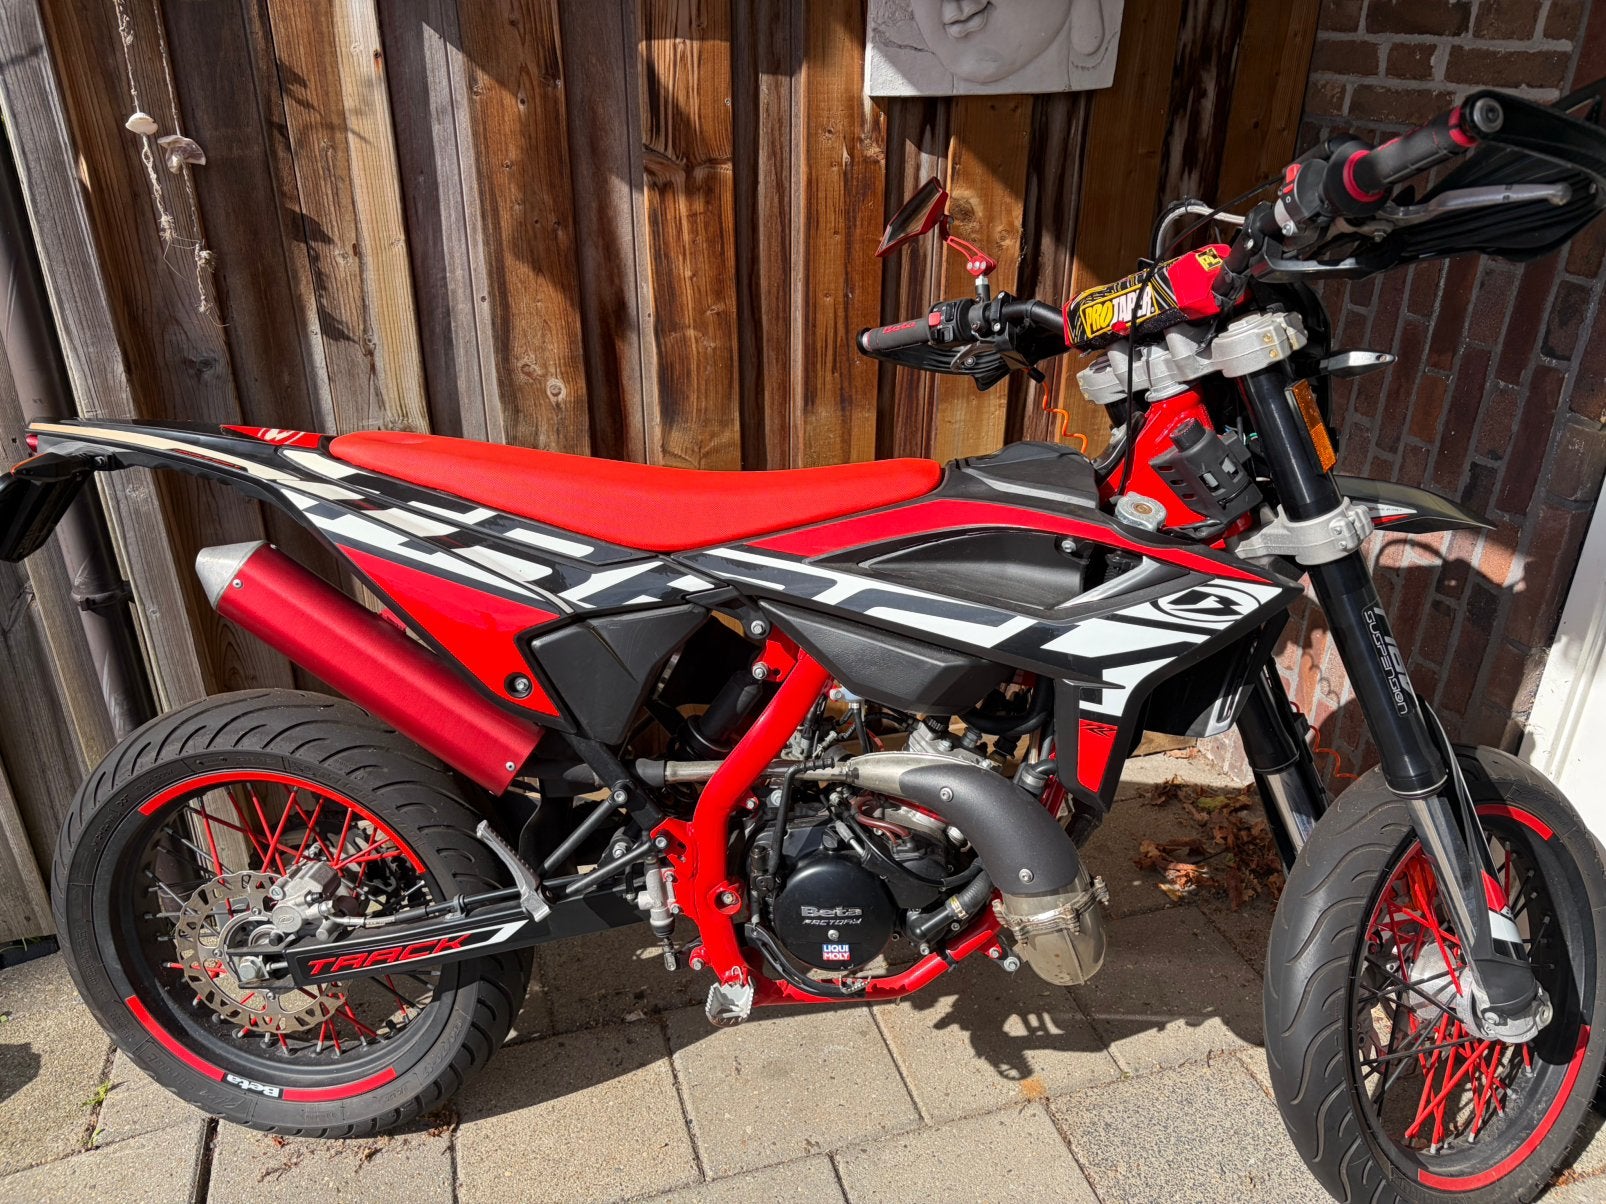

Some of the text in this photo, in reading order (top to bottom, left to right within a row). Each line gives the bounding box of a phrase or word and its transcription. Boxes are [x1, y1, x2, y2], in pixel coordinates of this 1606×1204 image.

[801, 905, 862, 917] Beta
[308, 933, 471, 975] TRACK
[823, 944, 849, 952] LIQUI
[823, 952, 850, 960] MOLY
[226, 1074, 280, 1097] Beta
